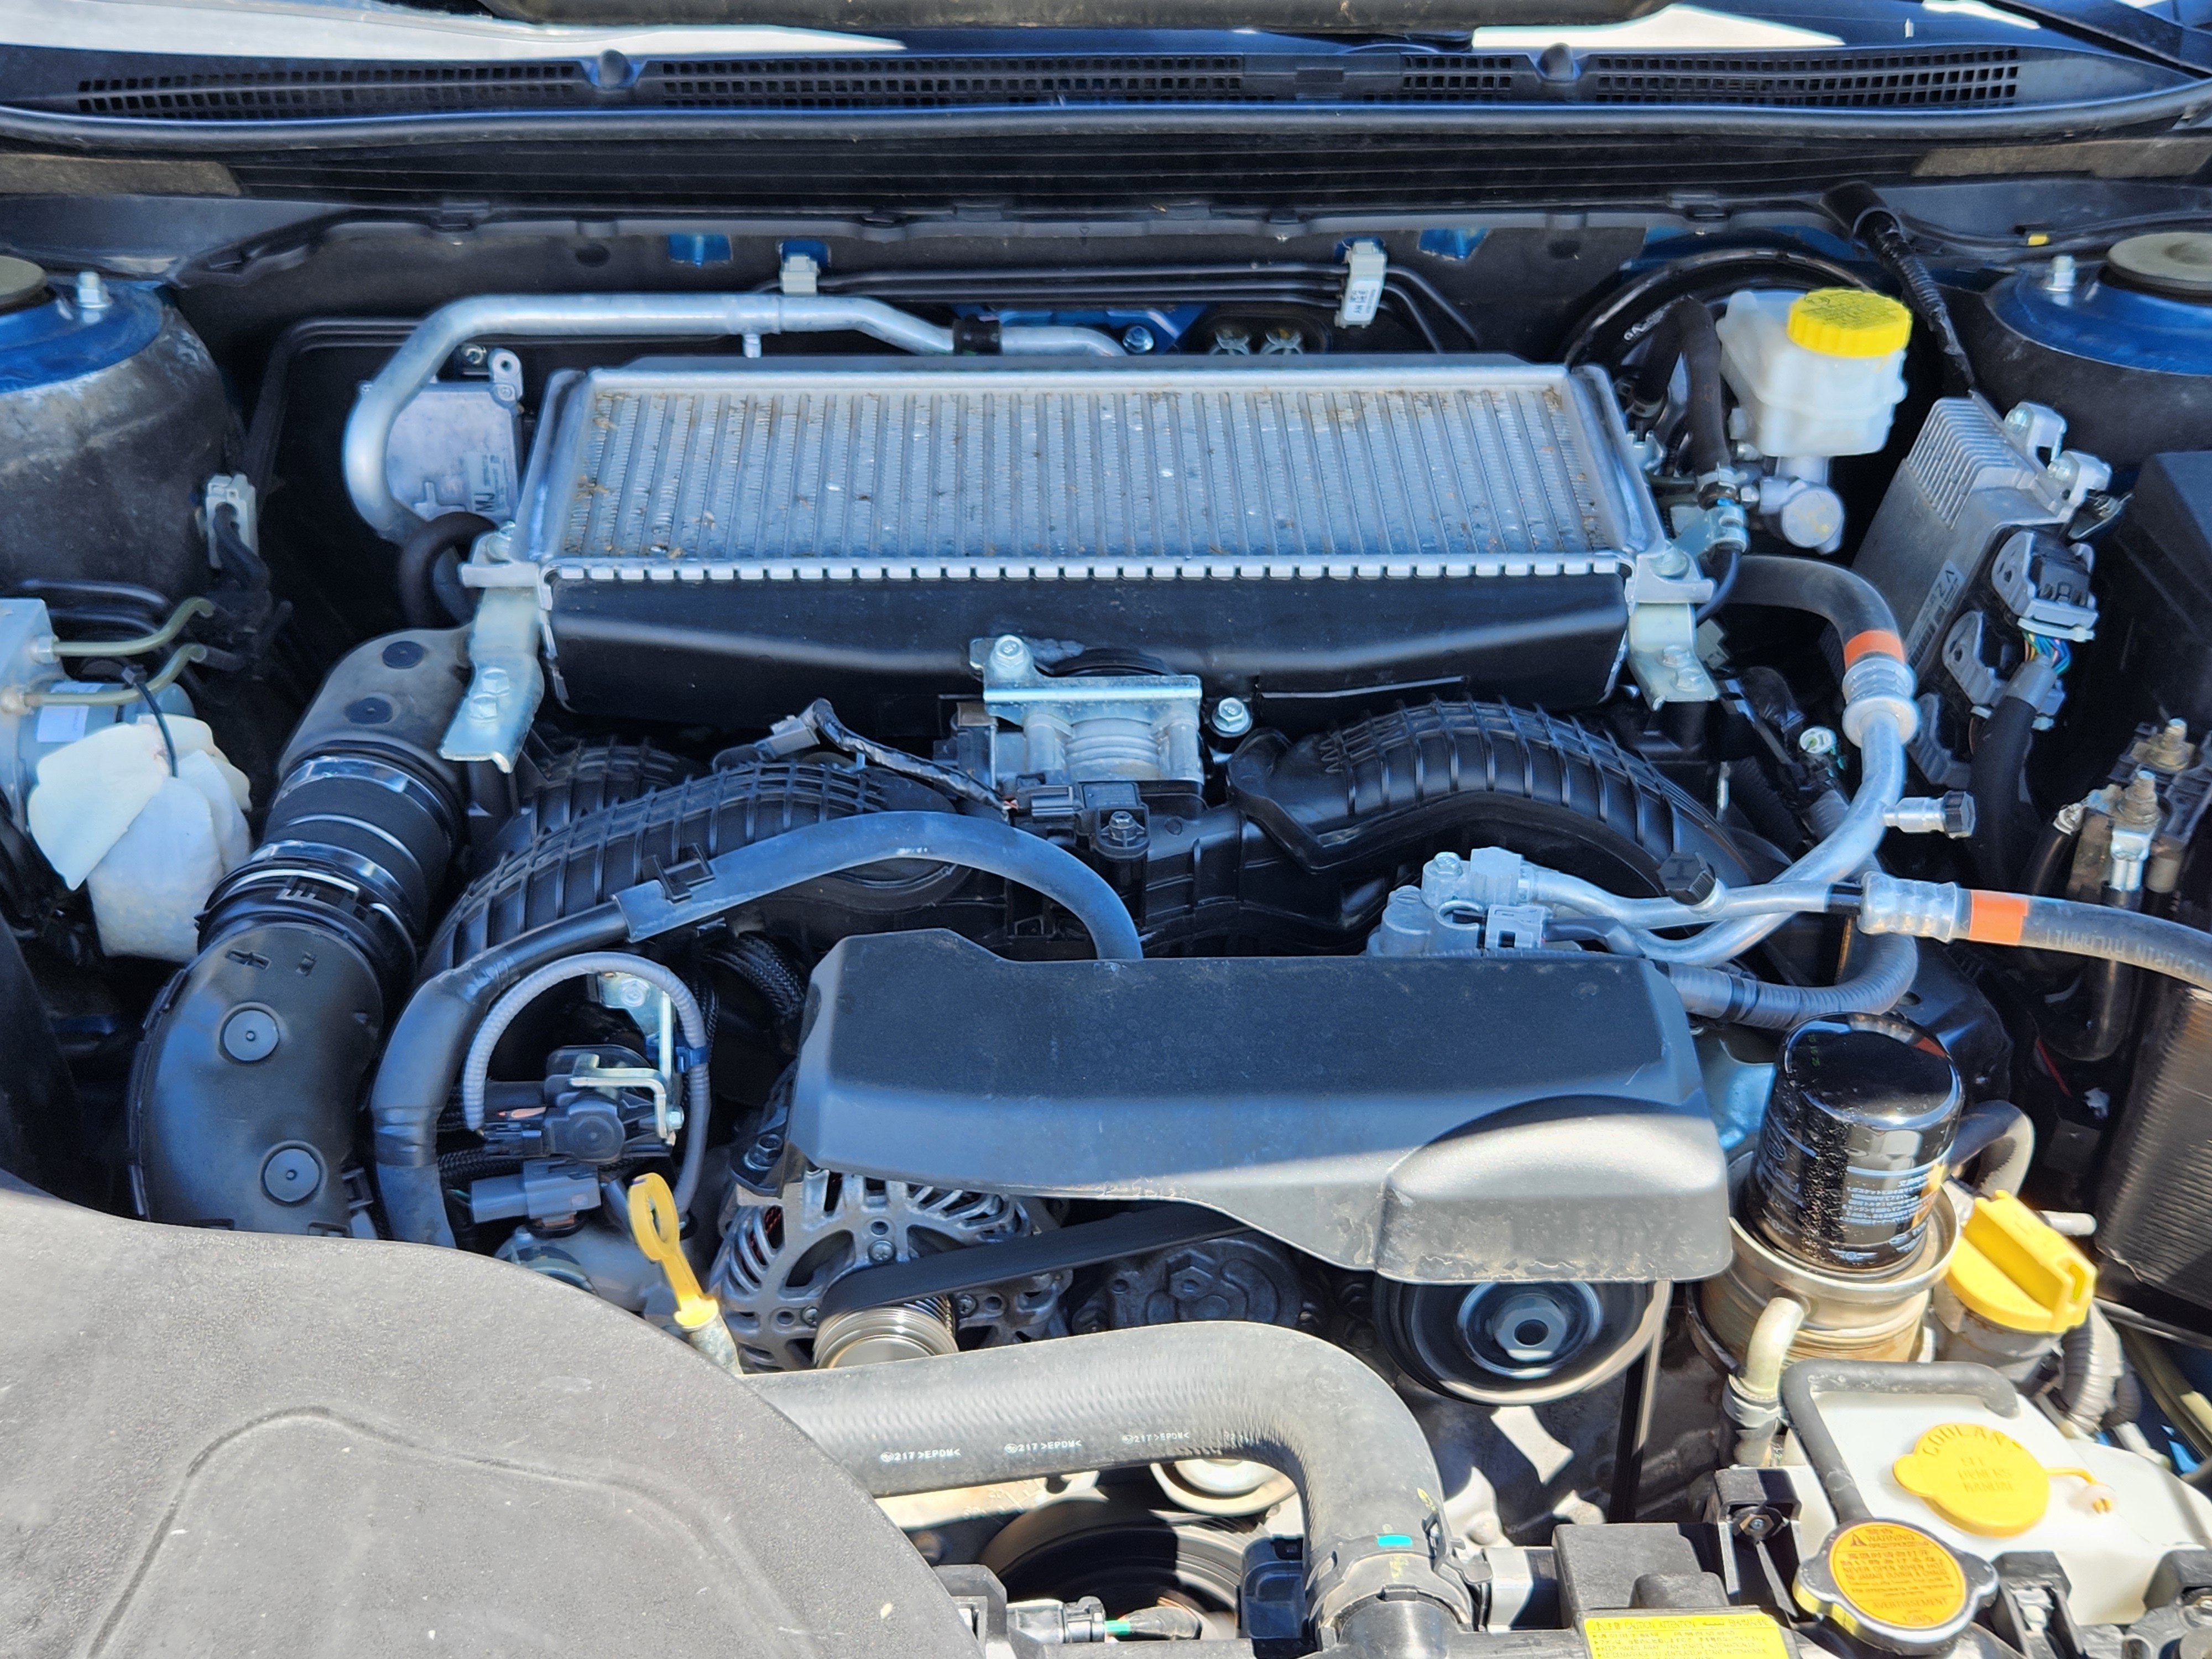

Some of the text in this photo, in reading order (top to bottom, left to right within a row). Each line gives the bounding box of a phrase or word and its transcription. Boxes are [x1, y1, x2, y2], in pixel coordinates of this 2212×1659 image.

[1866, 1534, 1915, 1542] WARNING
[1873, 1597, 1947, 1609] AVERTISSEMENT
[1624, 1621, 1656, 1630] CAUTION
